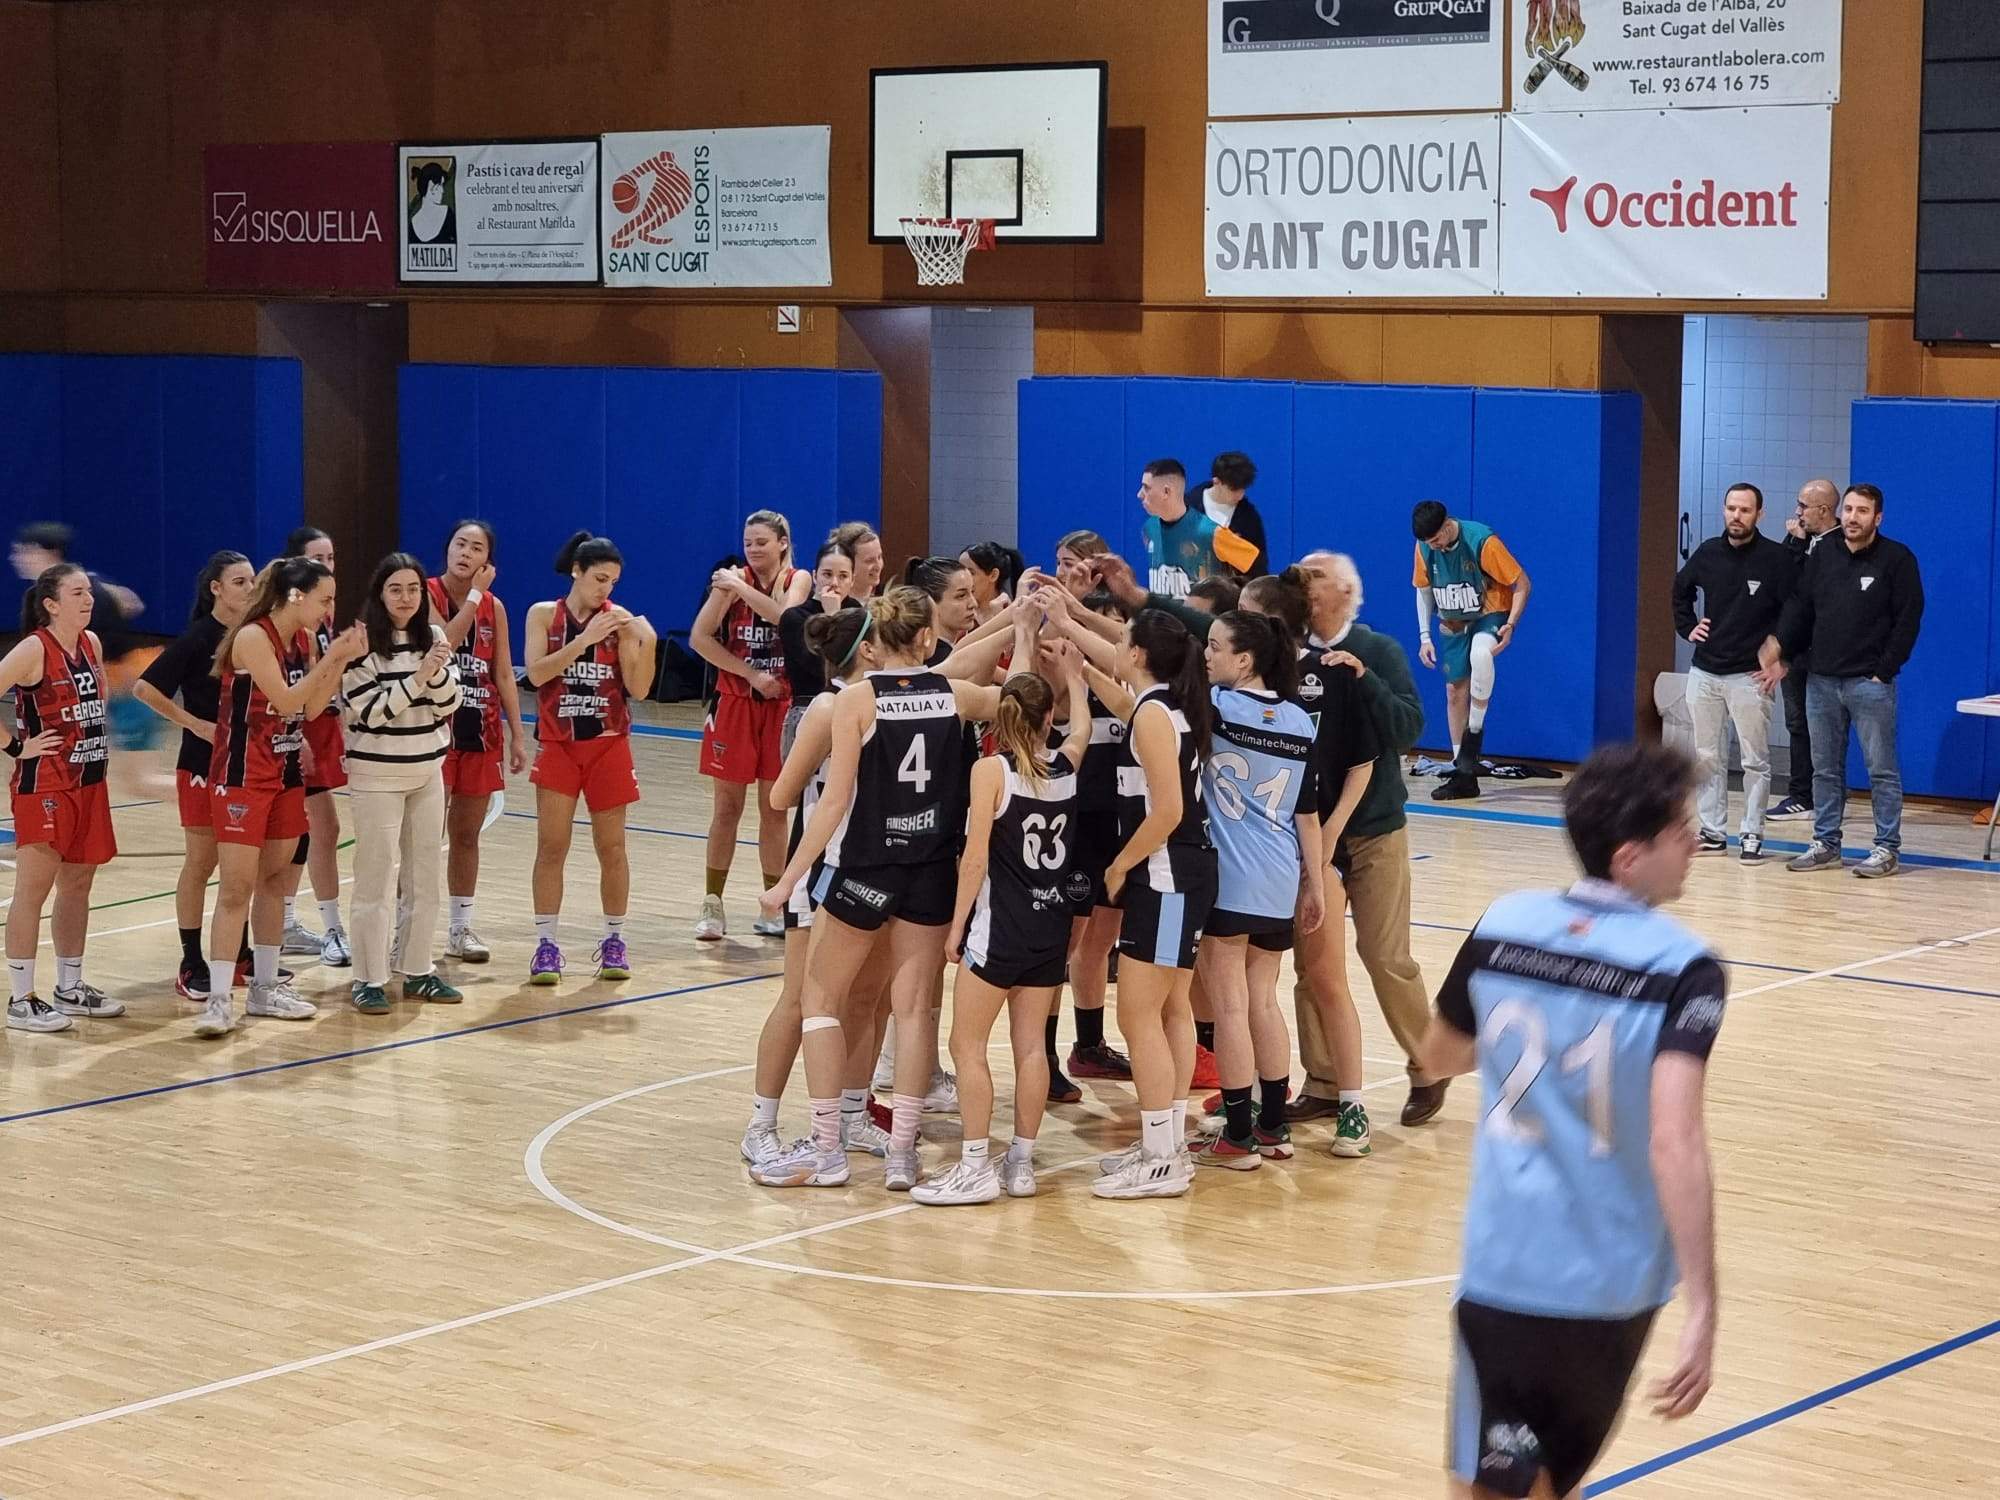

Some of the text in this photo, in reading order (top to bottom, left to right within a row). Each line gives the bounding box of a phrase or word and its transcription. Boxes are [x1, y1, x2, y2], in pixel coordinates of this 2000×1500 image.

[1622, 0, 1786, 15] Baixada de l'Alba, 20
[1227, 17, 1251, 44] G
[1623, 16, 1785, 39] Sant Cugat del Vallès
[1592, 49, 1825, 72] www.restaurantlabolera.com
[1629, 75, 1769, 94] Tel. 93 674 16 75
[510, 165, 534, 177] cava
[536, 161, 551, 176] de
[554, 160, 584, 180] regal
[1216, 141, 1488, 197] ORTODONCIA
[466, 180, 584, 195] celebrant el teu aniversari
[694, 145, 710, 243] ESPORTS
[721, 180, 748, 188] Rambla
[749, 179, 760, 188] del
[492, 199, 513, 212] amb
[751, 193, 767, 202] Sant
[768, 193, 791, 203] Cugat
[792, 193, 804, 201] del
[1584, 179, 1797, 228] Occident
[477, 216, 576, 230] al Restaurant Matilda
[721, 209, 757, 217] Barcelona
[251, 210, 382, 243] SISQUELLA
[1215, 218, 1488, 270] SANT CUGAT
[411, 247, 453, 267] MATILDA
[608, 252, 709, 273] SANT CUGAT
[74, 671, 97, 696] 22
[877, 699, 948, 714] NATALIA V.
[897, 733, 931, 793] 4
[1204, 751, 1292, 832] 61
[1021, 813, 1067, 870] 63
[1483, 997, 1617, 1157] 21
